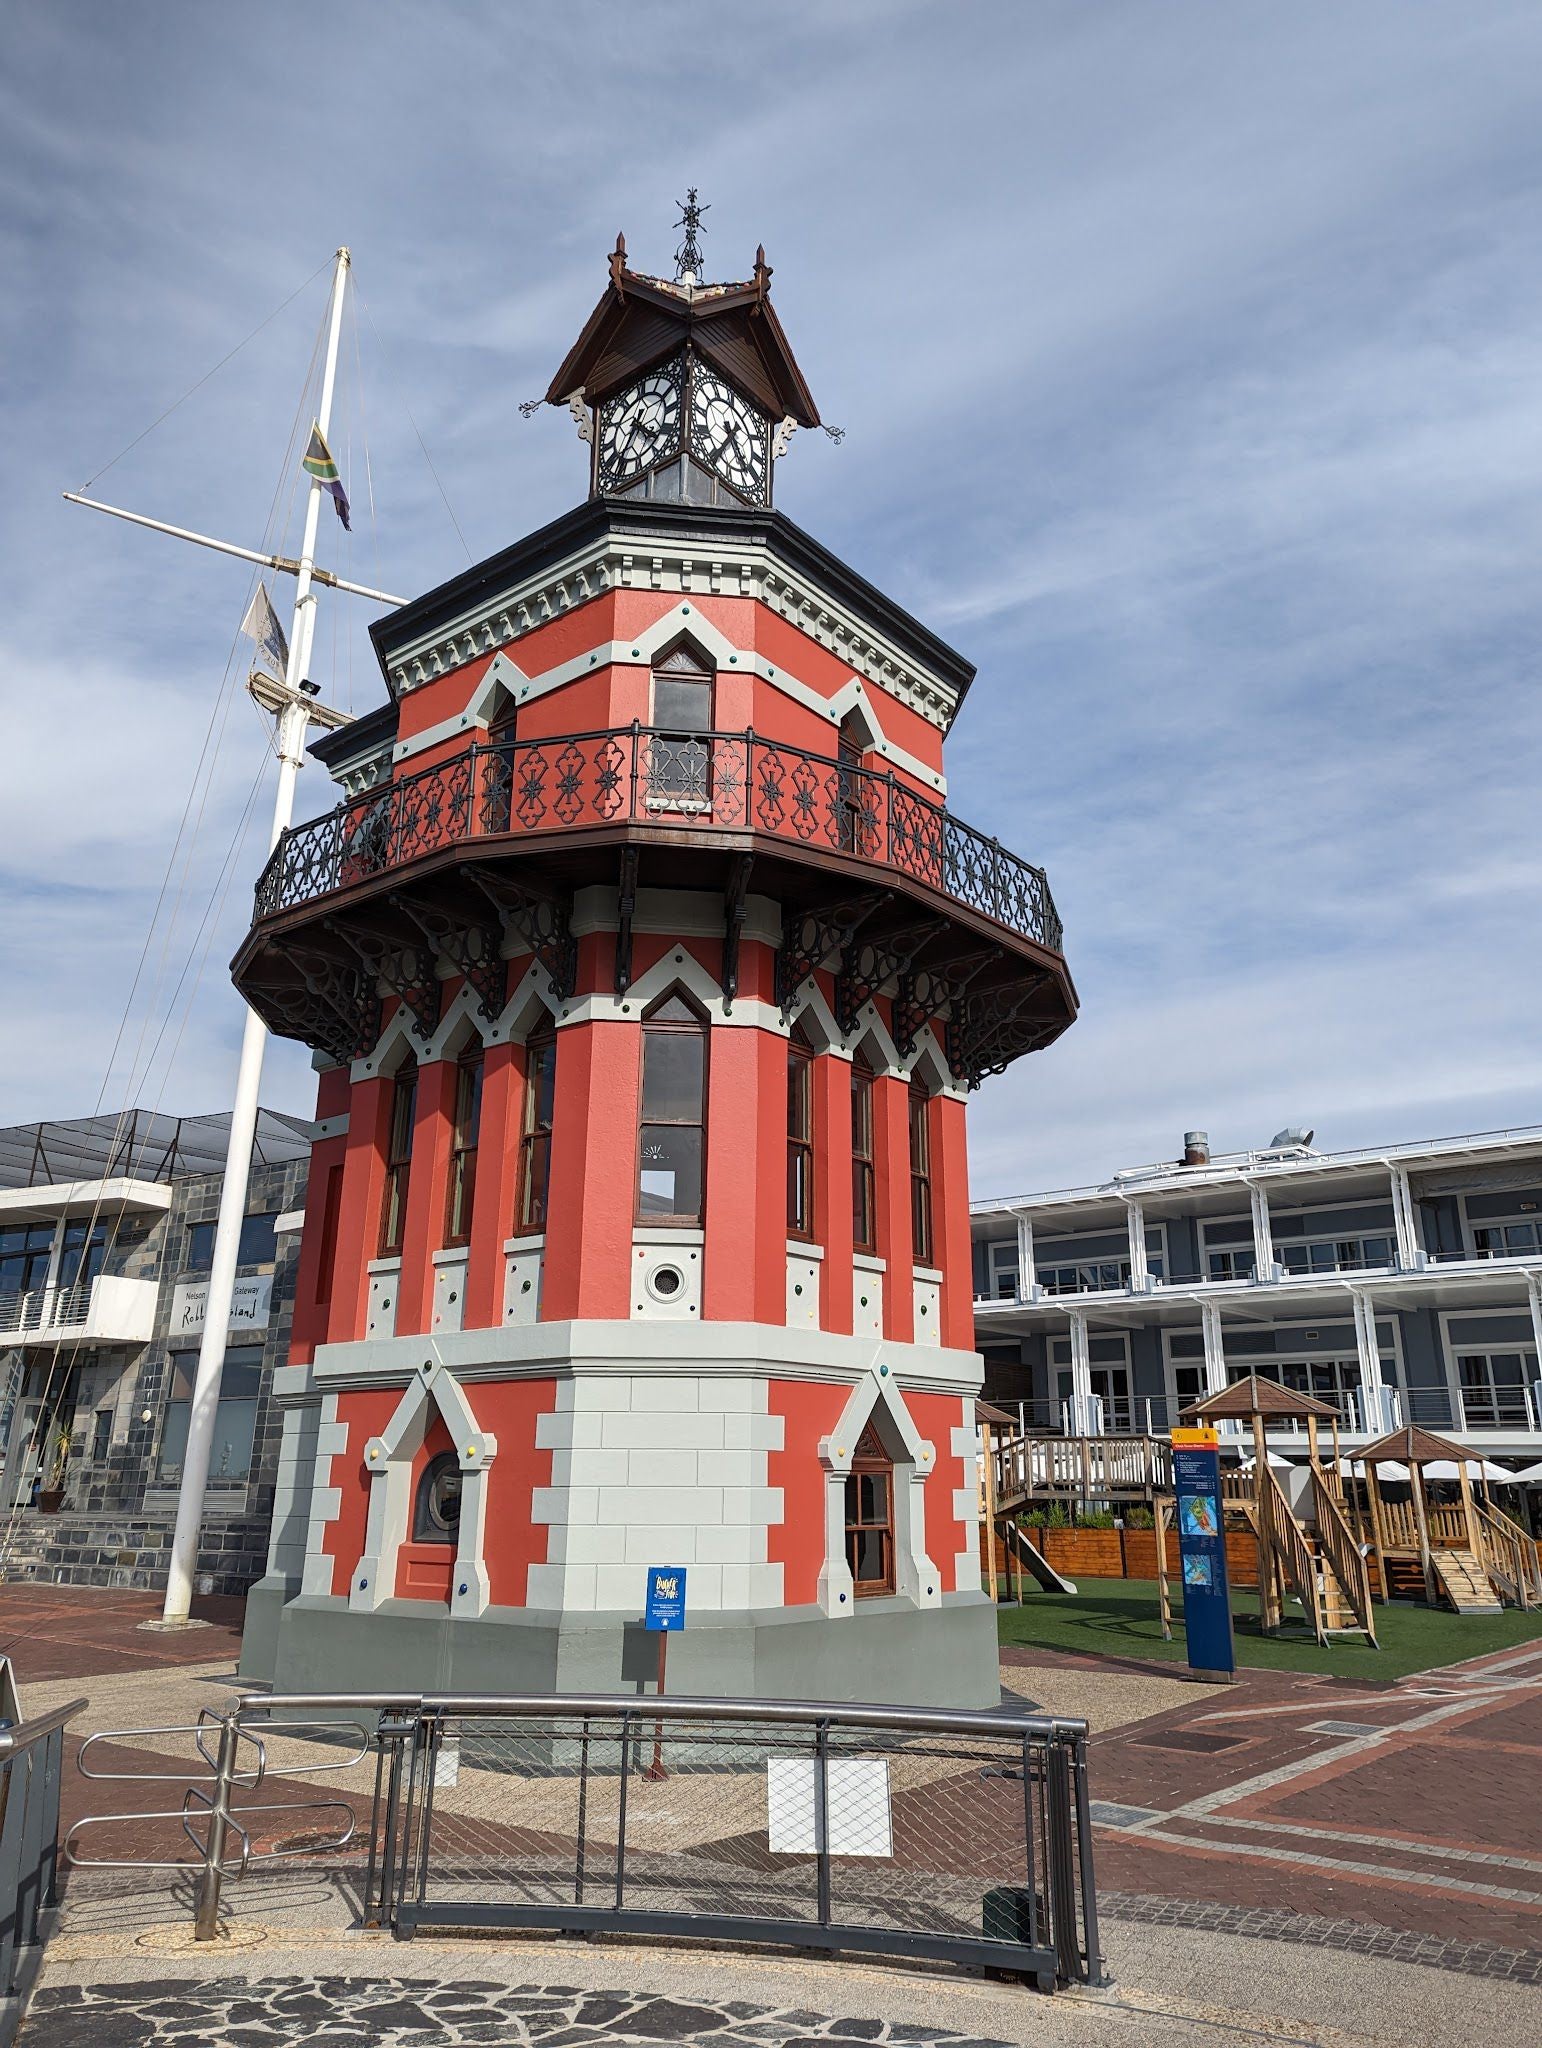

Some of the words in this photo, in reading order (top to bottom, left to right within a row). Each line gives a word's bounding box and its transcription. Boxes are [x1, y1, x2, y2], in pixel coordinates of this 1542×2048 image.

[186, 1292, 206, 1301] Nelson
[235, 1286, 260, 1295] Gateway
[181, 1303, 206, 1329] Robb
[229, 1299, 257, 1319] sland
